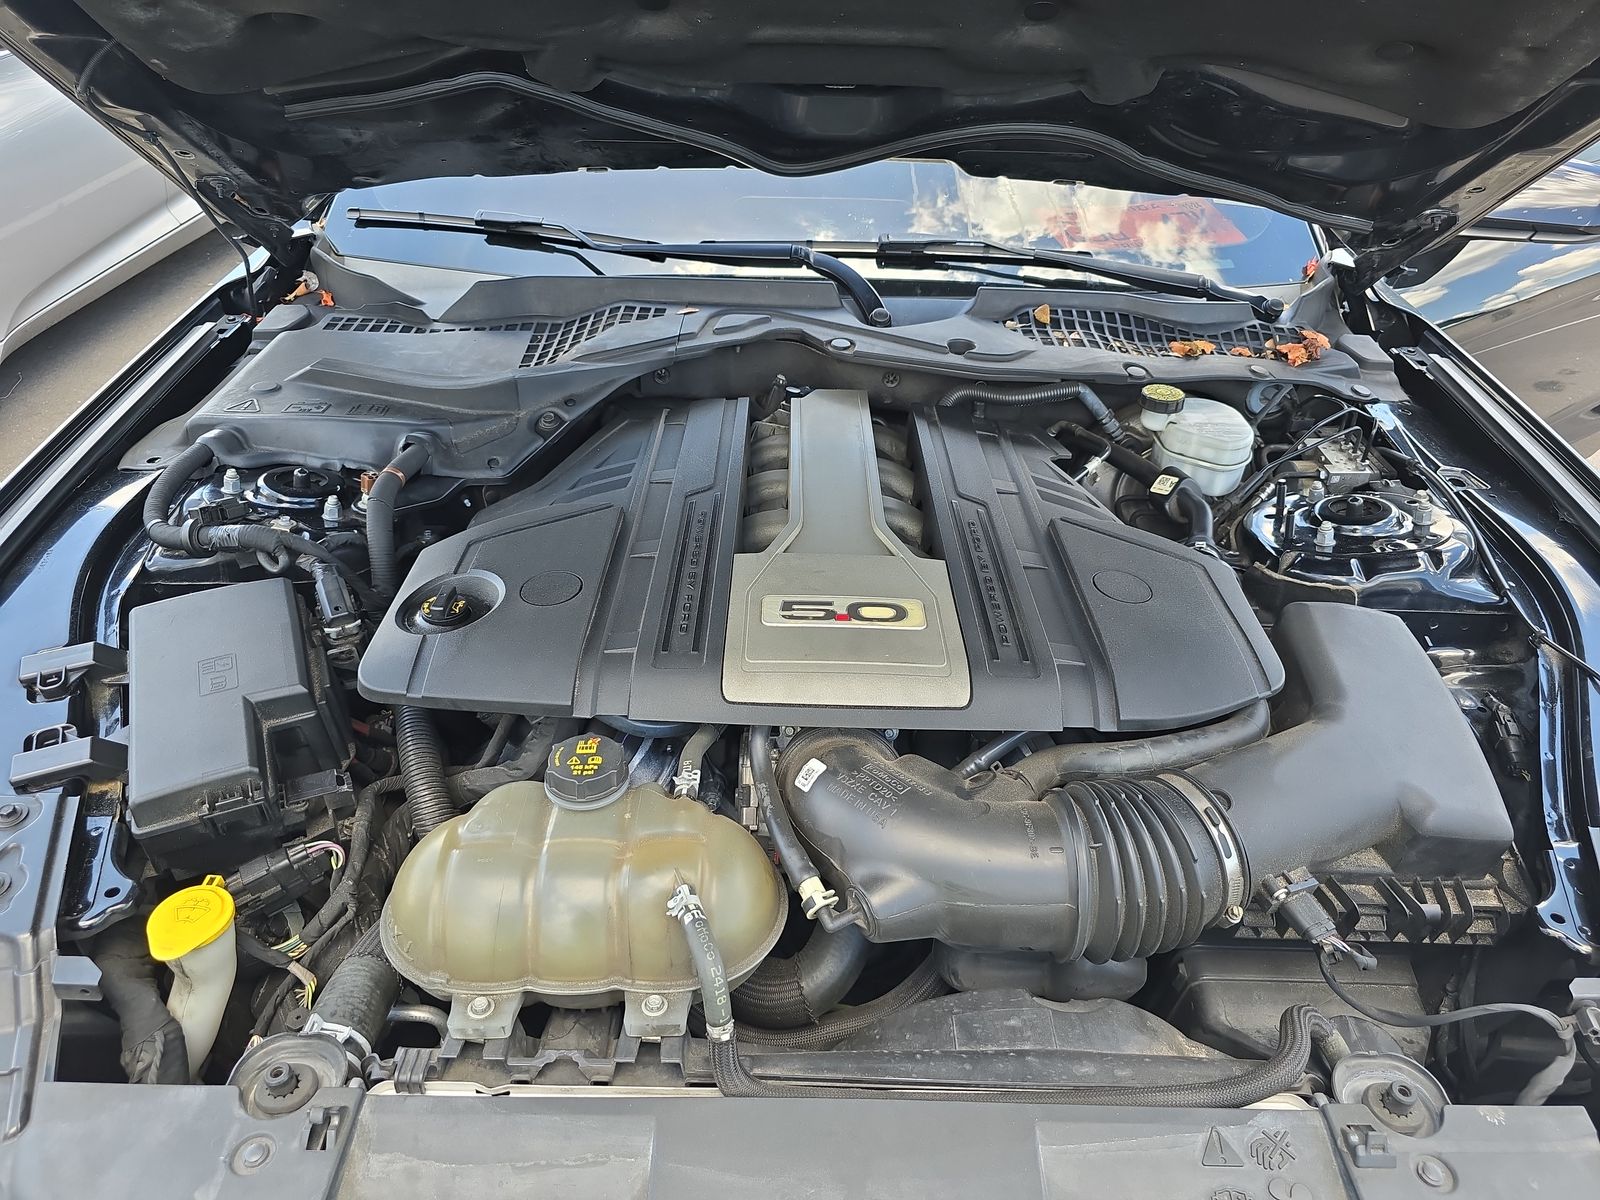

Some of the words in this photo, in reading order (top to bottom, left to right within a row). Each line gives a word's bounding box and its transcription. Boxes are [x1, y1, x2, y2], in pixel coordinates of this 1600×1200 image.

[690, 510, 707, 568] POWERED
[687, 571, 697, 590] BY
[679, 594, 693, 635] FORD
[779, 599, 909, 622] 5.0
[826, 783, 856, 803] MADE
[854, 800, 867, 811] IN
[868, 792, 891, 810] CAV
